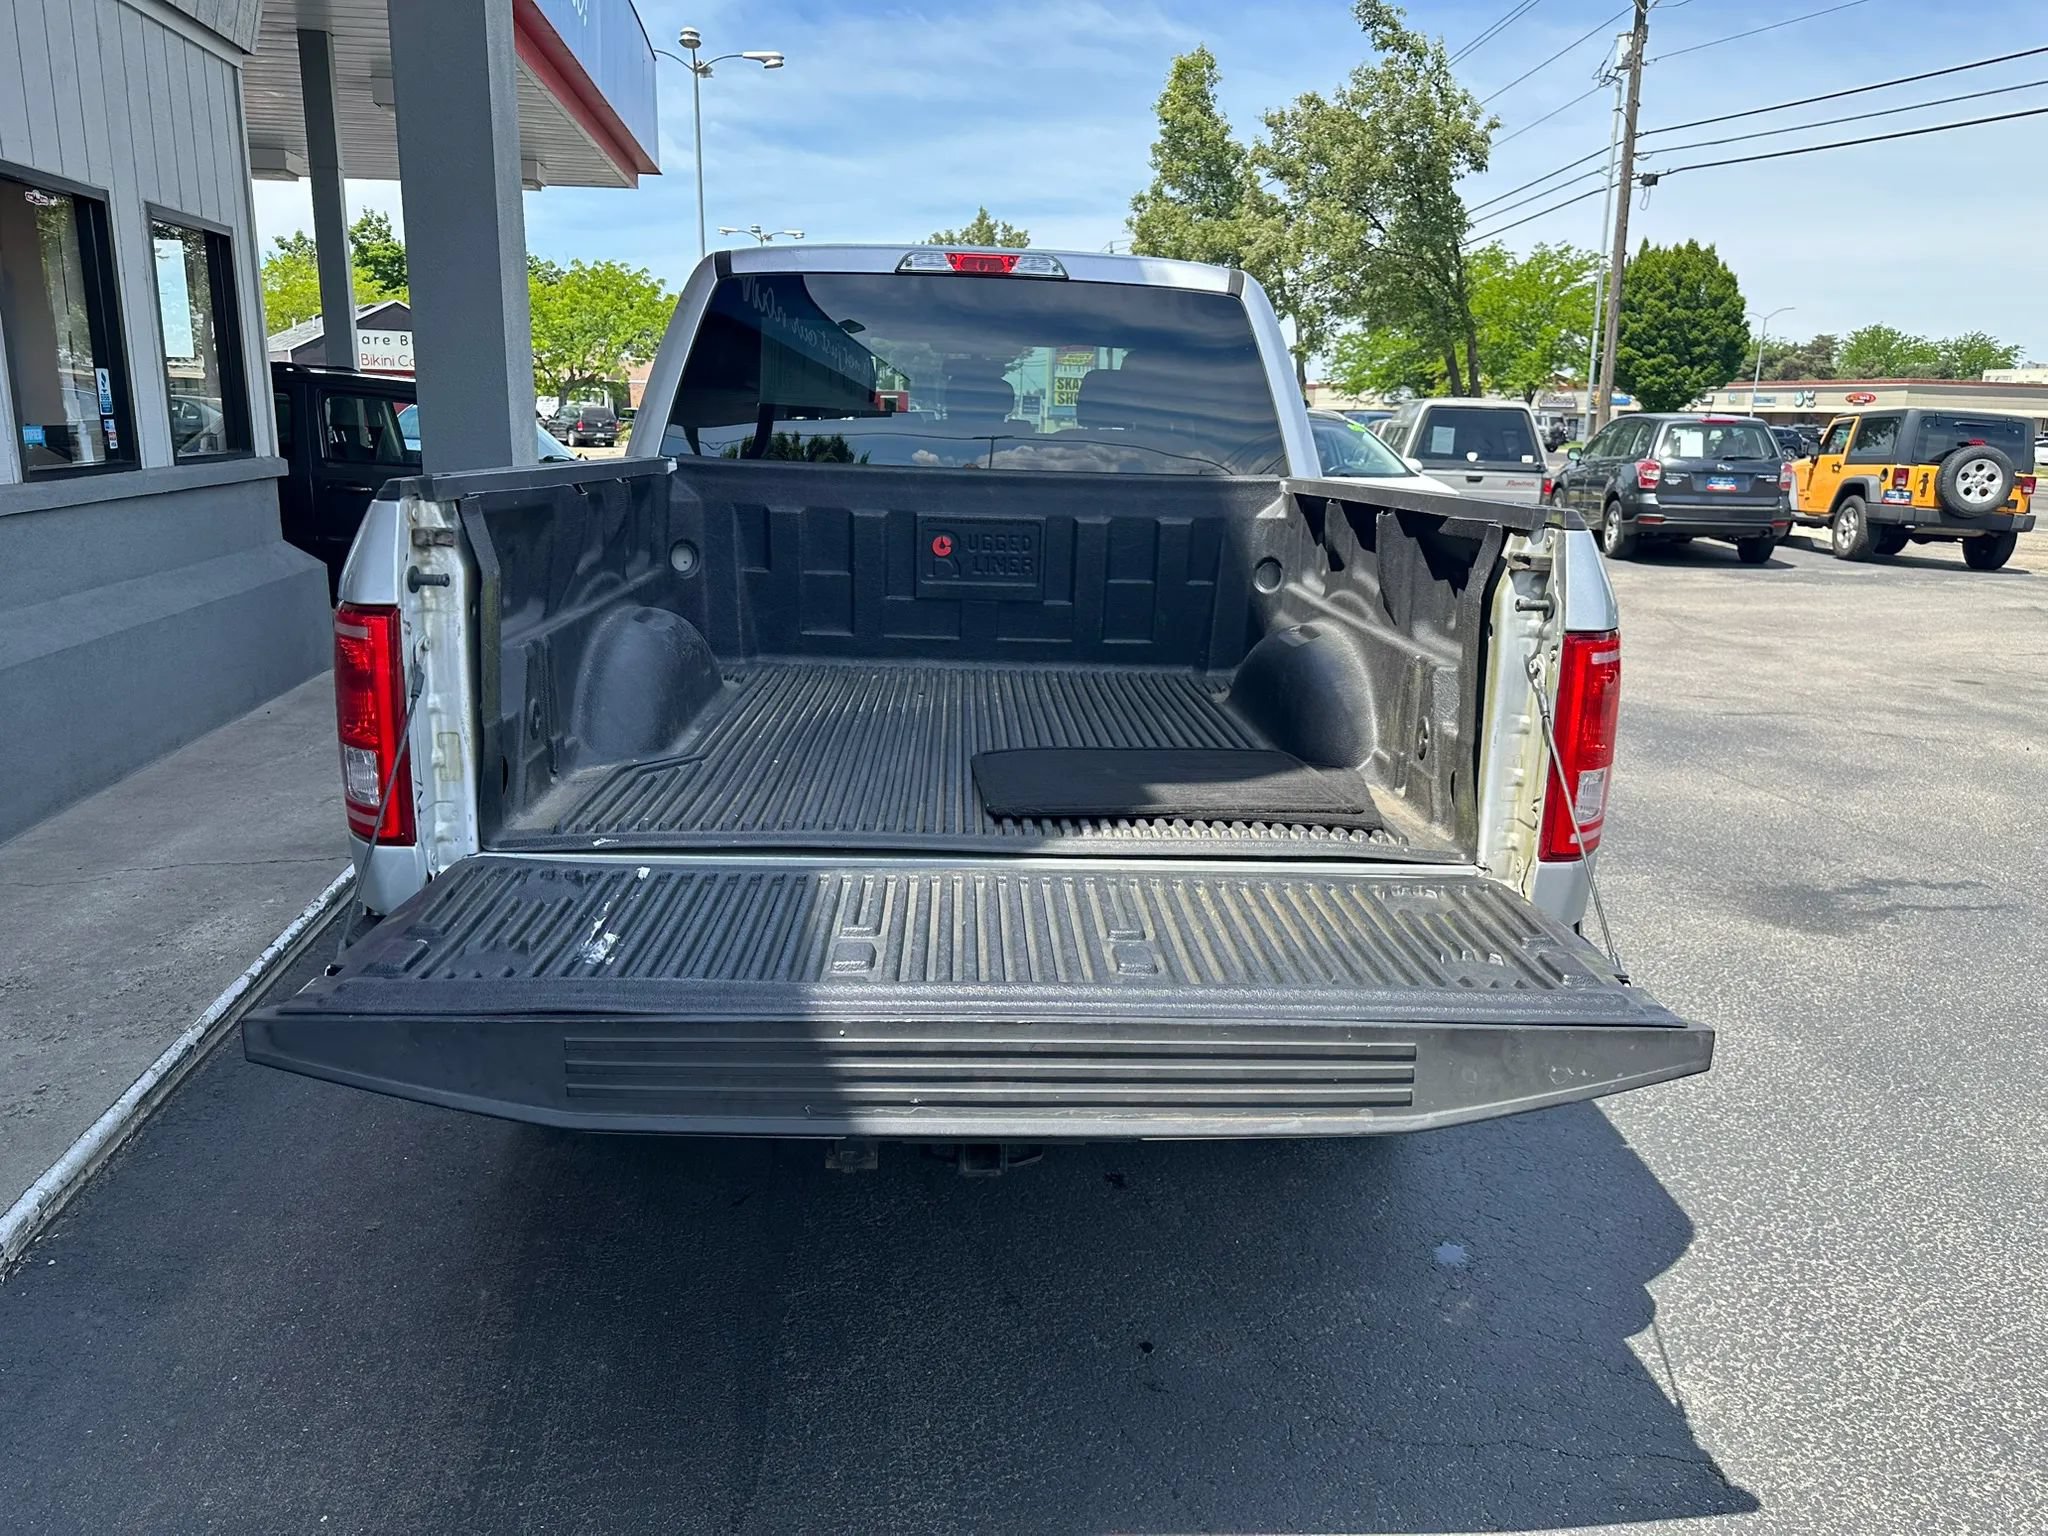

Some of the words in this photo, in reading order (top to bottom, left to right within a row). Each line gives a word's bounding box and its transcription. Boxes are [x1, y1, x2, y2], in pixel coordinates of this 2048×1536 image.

[361, 336, 391, 345] are
[400, 335, 409, 346] B
[360, 353, 395, 367] Bikini
[972, 555, 1033, 576] LINER
